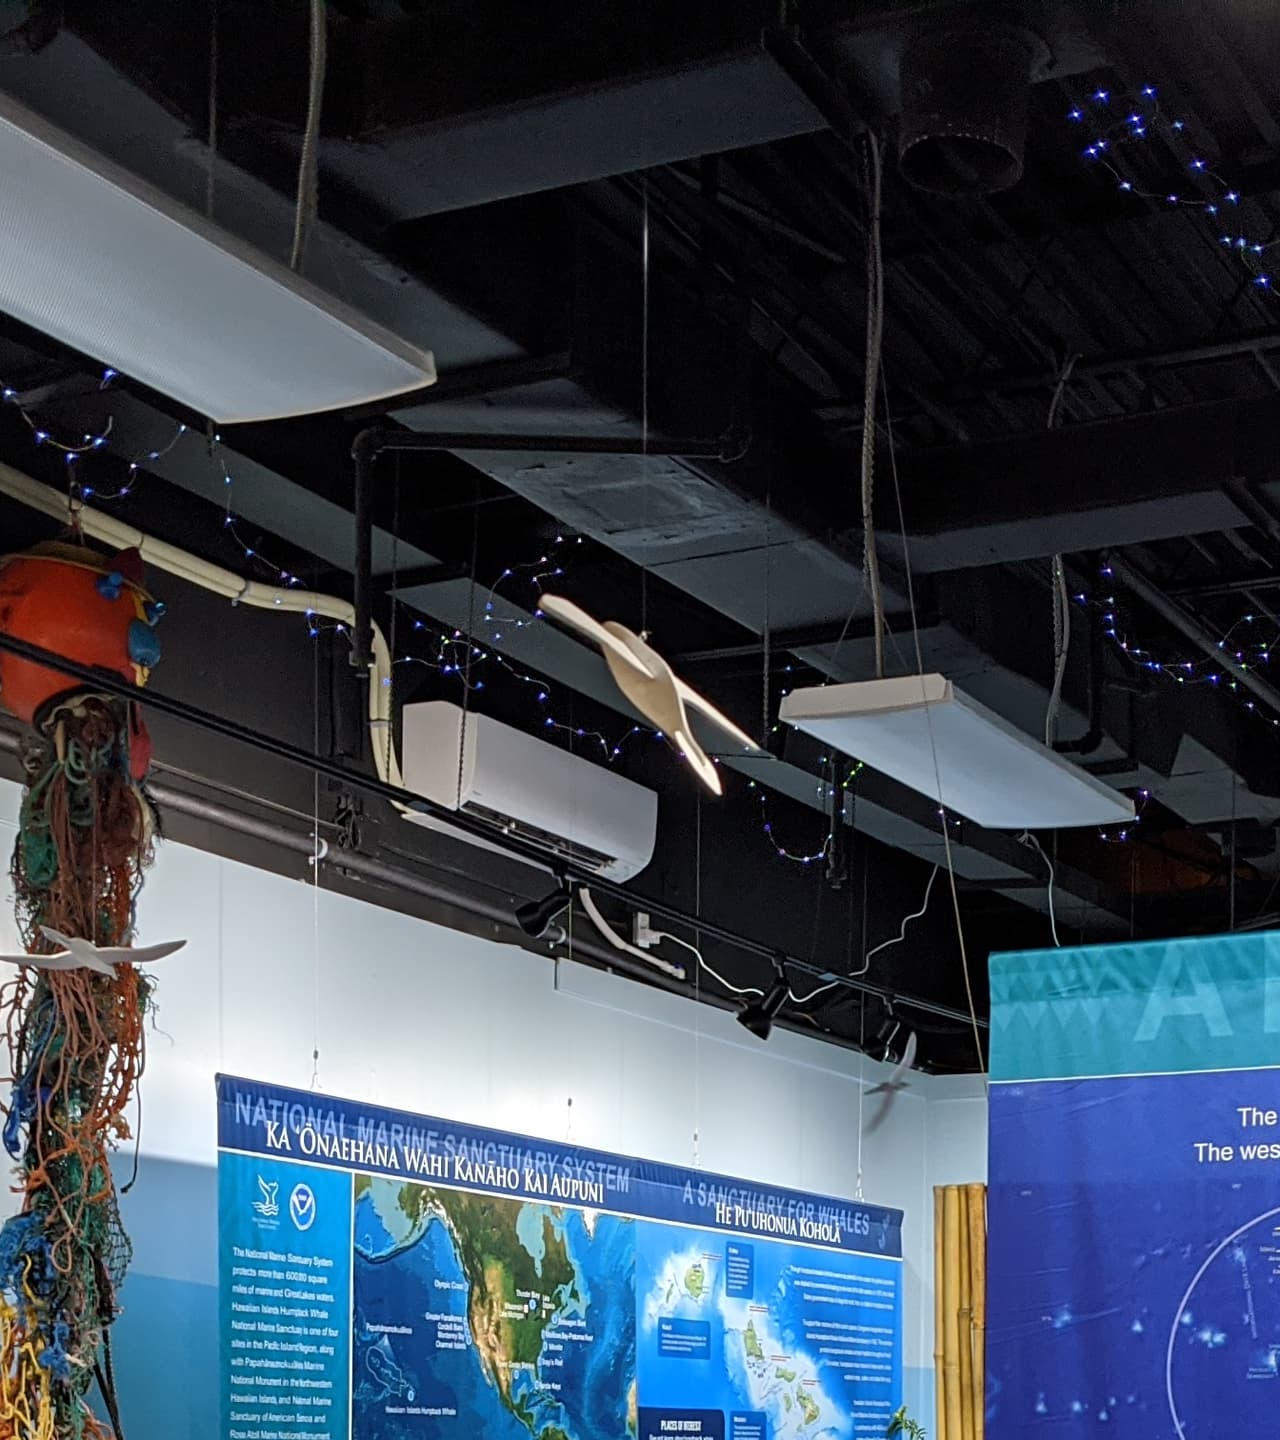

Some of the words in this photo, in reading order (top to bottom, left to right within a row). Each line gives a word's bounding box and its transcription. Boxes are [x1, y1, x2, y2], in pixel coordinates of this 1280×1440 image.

[1237, 1107, 1277, 1127] The
[235, 1092, 345, 1139] NATIONAL
[358, 1116, 439, 1153] MARINE
[444, 1134, 559, 1178] SANCTUARY
[562, 1155, 629, 1193] SYSTEM
[266, 1120, 291, 1151] KA
[404, 1146, 449, 1178] WAHI
[524, 1167, 548, 1194] KAI
[550, 1173, 604, 1203] AUPUNI
[1194, 1143, 1233, 1162] The
[682, 1179, 694, 1205] A
[697, 1182, 785, 1214] SANCTUARY
[788, 1201, 814, 1221] FOR
[818, 1205, 870, 1236] WHALES
[715, 1202, 731, 1225] HE
